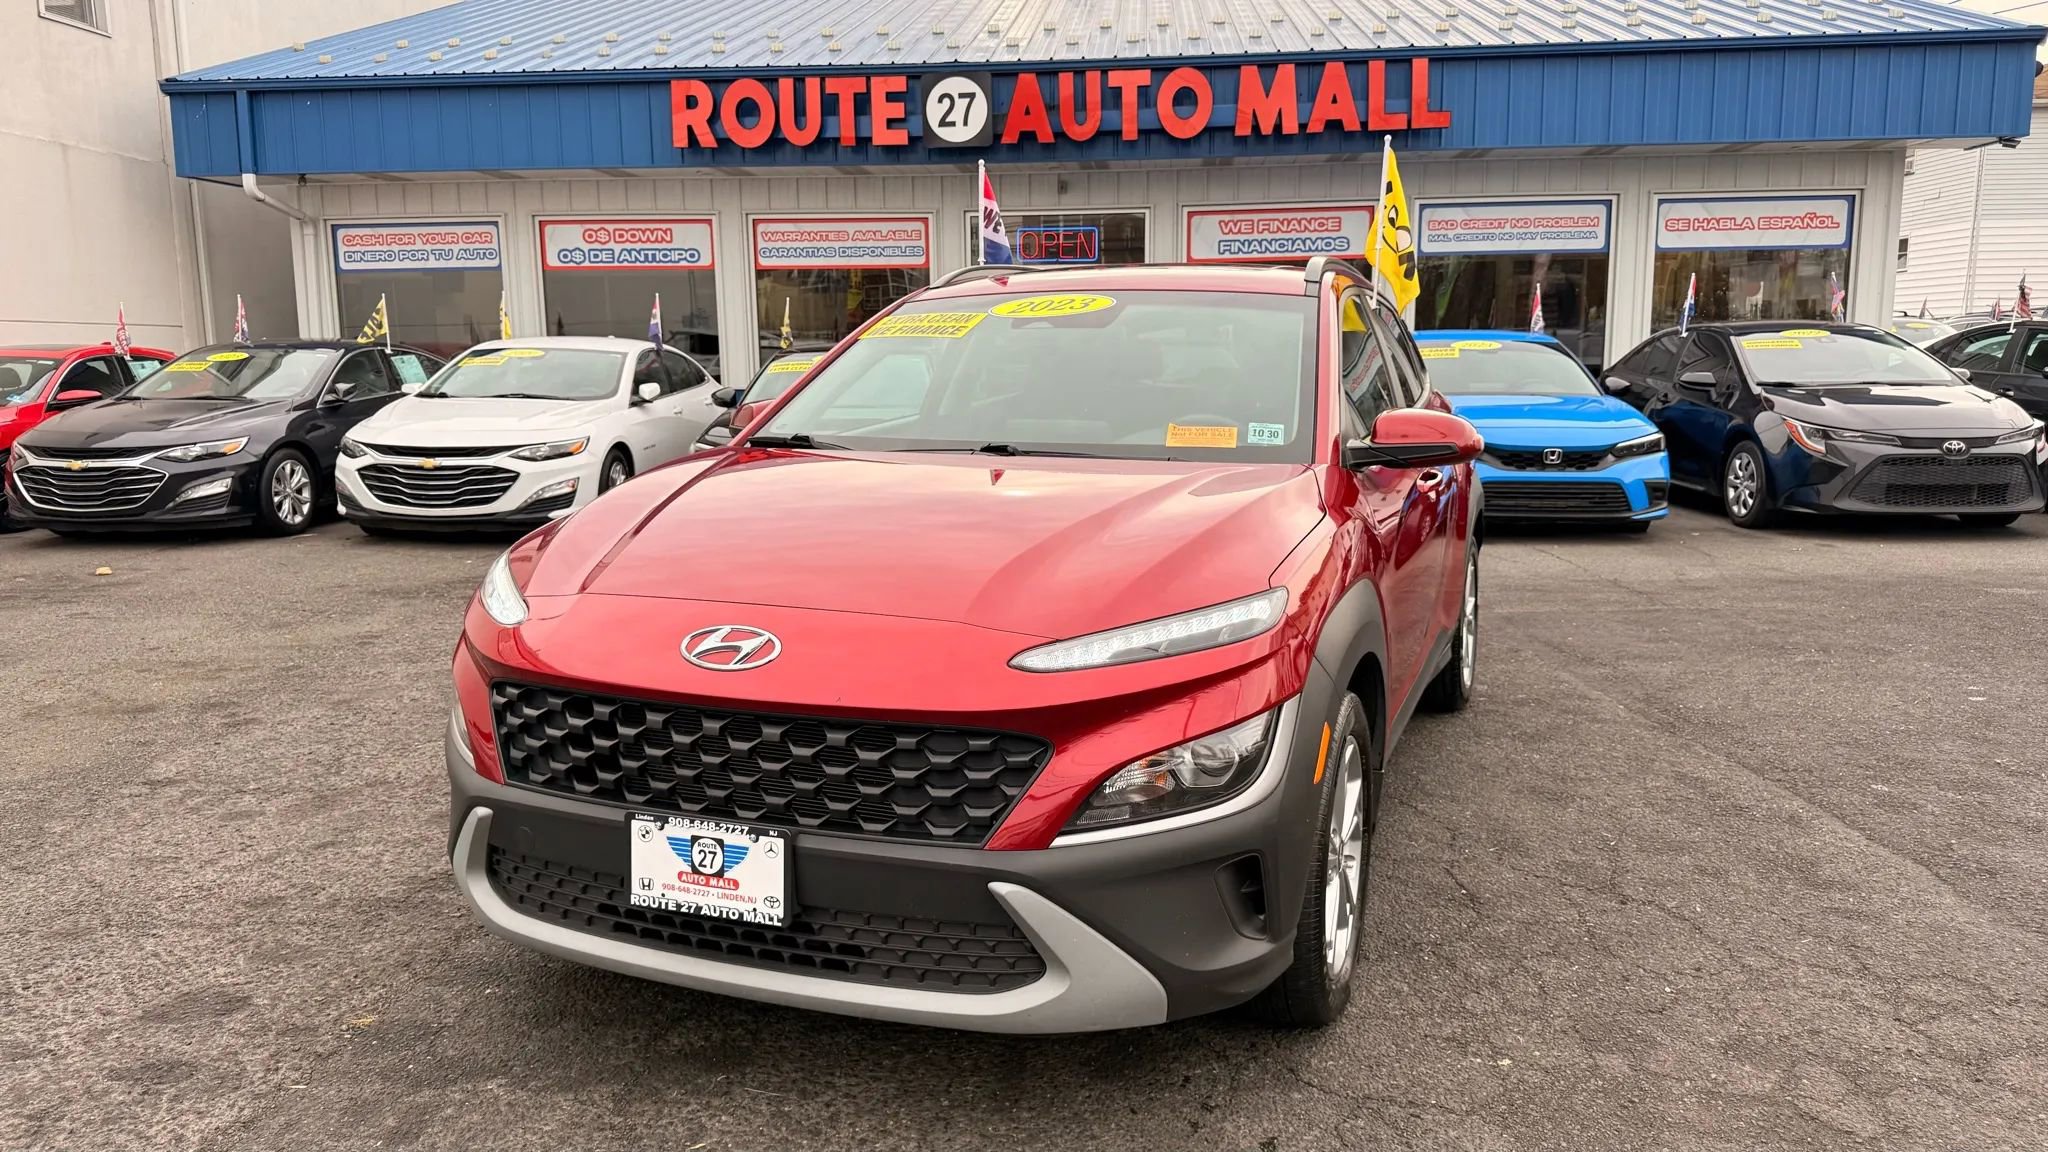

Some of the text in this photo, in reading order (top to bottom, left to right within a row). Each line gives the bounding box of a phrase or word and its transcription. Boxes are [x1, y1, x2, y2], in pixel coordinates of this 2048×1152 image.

[670, 58, 1451, 148] ROUTE 27 AUTO MALL
[1219, 217, 1342, 235] WE FINANCE
[1428, 217, 1600, 231] BAD CREDIT NO PROBLEM
[1665, 213, 1841, 232] SE HABLA ESPAÑOL
[343, 232, 493, 246] CASH FOR YOUR CAR
[614, 228, 672, 244] DOWN
[761, 230, 922, 242] WARRANTIES AVAILABLE
[1428, 231, 1598, 243] MAL CREDITO NO HAY PROBLEMA
[760, 247, 924, 259] GARANTIAS DISPONIBLES
[1020, 231, 1095, 259] OPEN
[1218, 237, 1349, 255] FINANCIAMOS
[344, 248, 498, 262] DINERO POR TU AUTO
[588, 248, 615, 264] DE
[618, 248, 700, 264] ANTICIPO
[1007, 297, 1097, 315] 2023
[881, 314, 979, 326] EXTRA CLEAN
[889, 326, 968, 336] FINANCE
[1252, 429, 1279, 439] 10 30
[668, 817, 749, 835] 908-648-2727
[697, 842, 717, 850] ROUTE
[698, 851, 718, 869] 27
[681, 873, 737, 890] AUTO MALL
[662, 884, 710, 898] 908-648-2727
[631, 894, 783, 927] ROUTE 27 AUTO MALL
